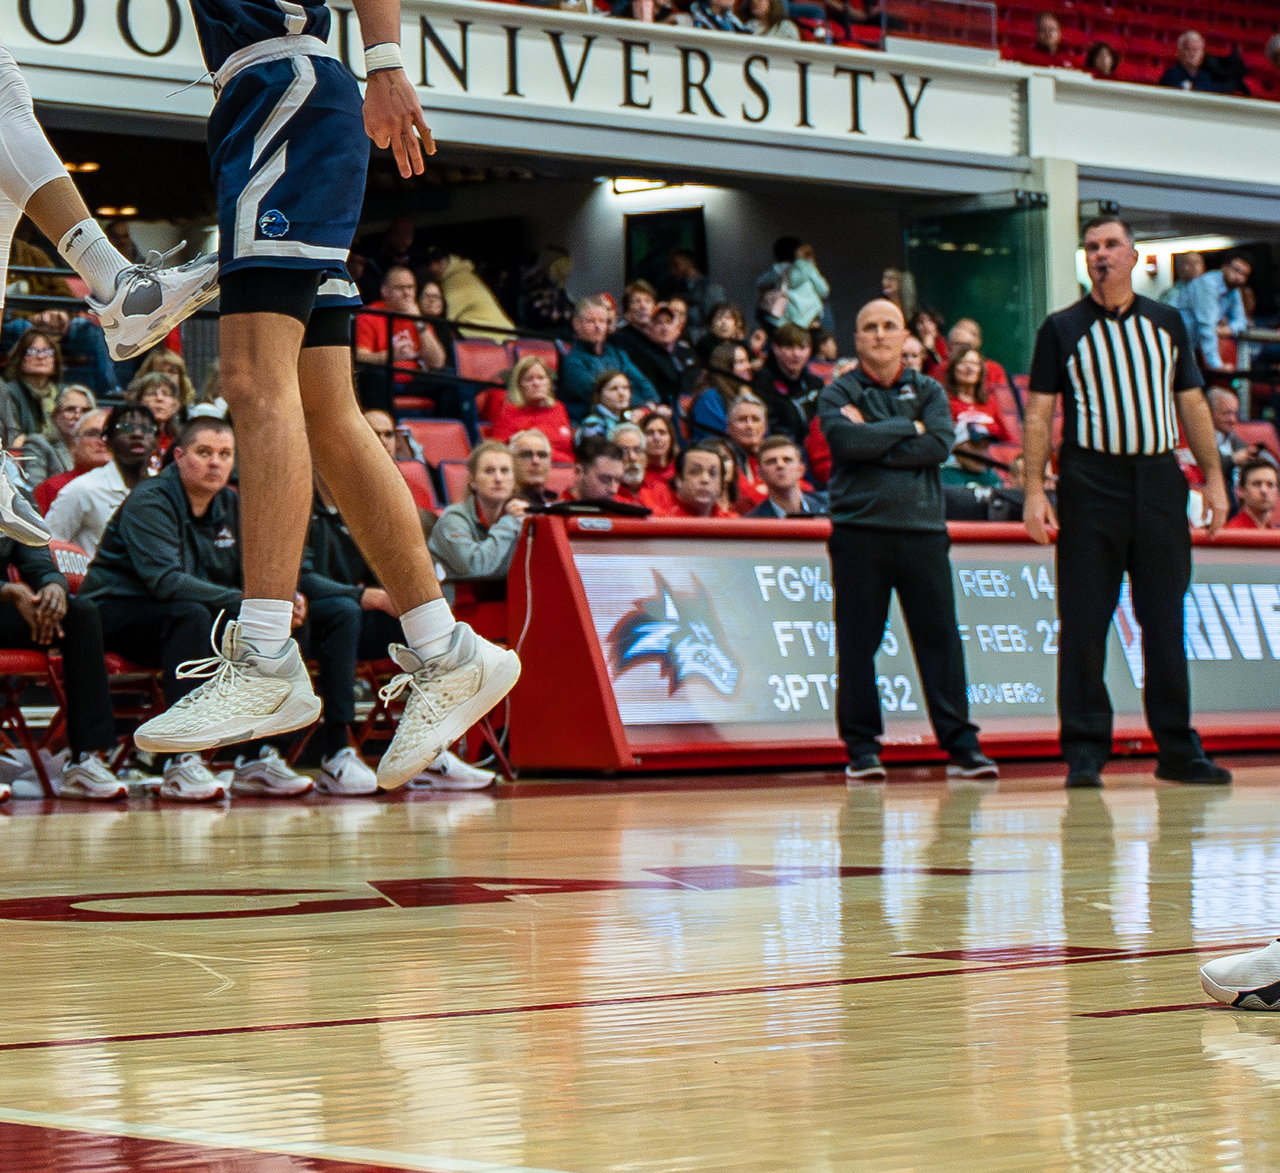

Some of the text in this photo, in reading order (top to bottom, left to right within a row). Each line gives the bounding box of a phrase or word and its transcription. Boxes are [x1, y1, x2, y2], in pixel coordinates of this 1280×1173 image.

[958, 569, 1016, 598] REB:
[976, 624, 1033, 653] REB:
[768, 674, 838, 711] 3PT
[876, 675, 918, 711] 32
